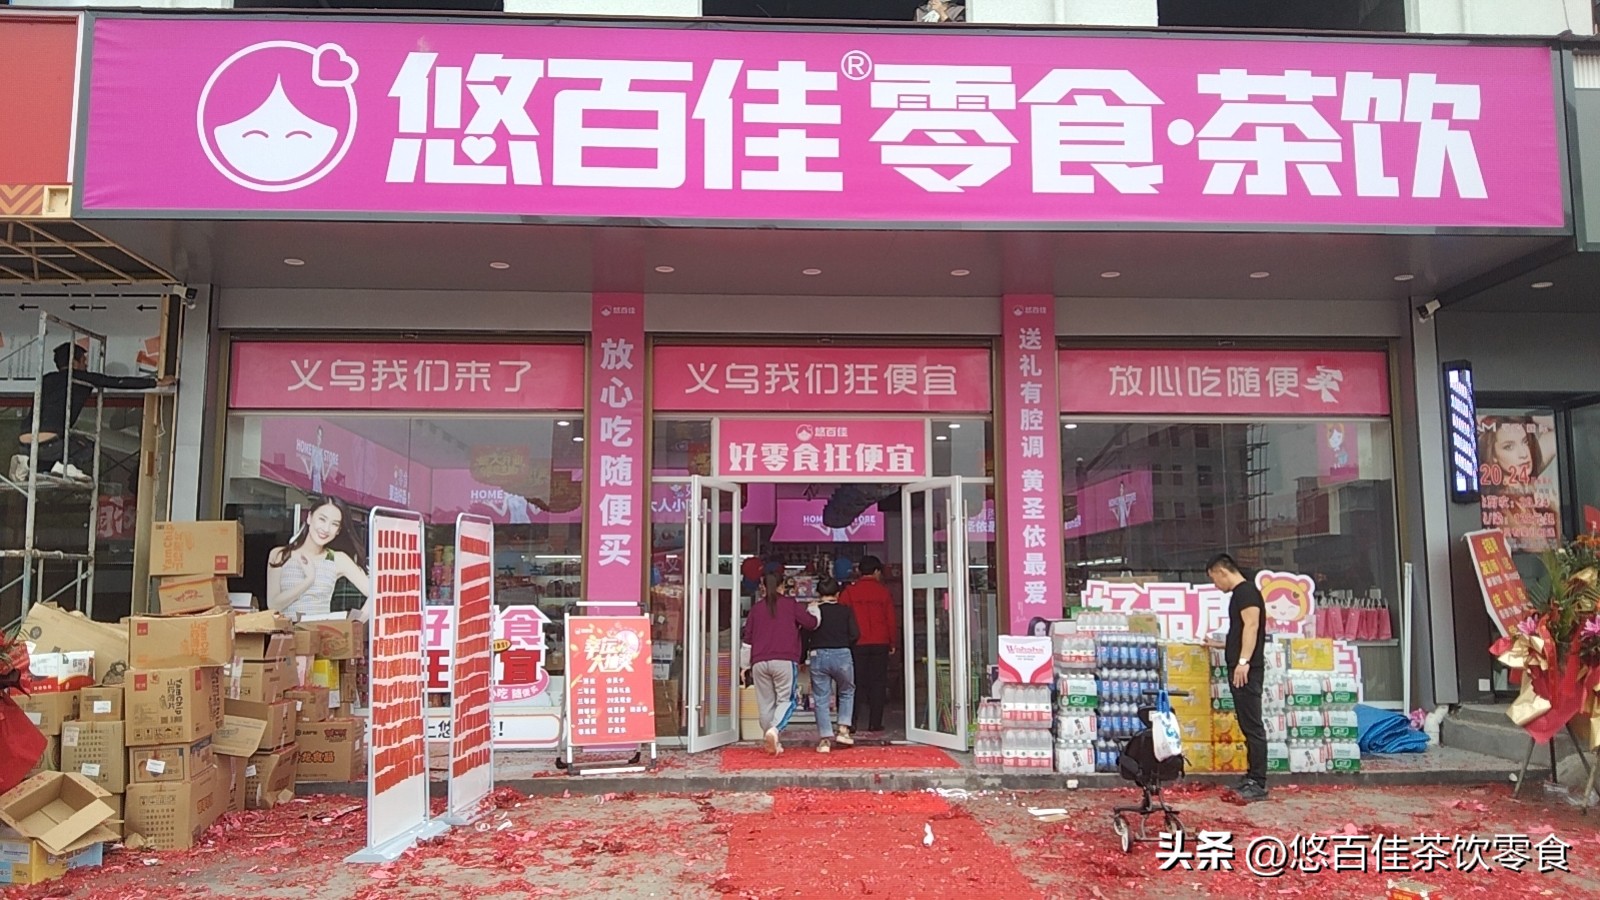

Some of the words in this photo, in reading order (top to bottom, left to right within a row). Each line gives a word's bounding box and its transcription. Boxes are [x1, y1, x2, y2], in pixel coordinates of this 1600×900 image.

[287, 359, 532, 393] 义乌我们来了
[685, 363, 958, 395] 义乌我们狂便宜
[1018, 327, 1045, 459] 送礼有腔调
[815, 426, 848, 438] 悠百佳
[598, 338, 635, 567] 放心吃随便买
[728, 442, 915, 473] 好零食狂便宜
